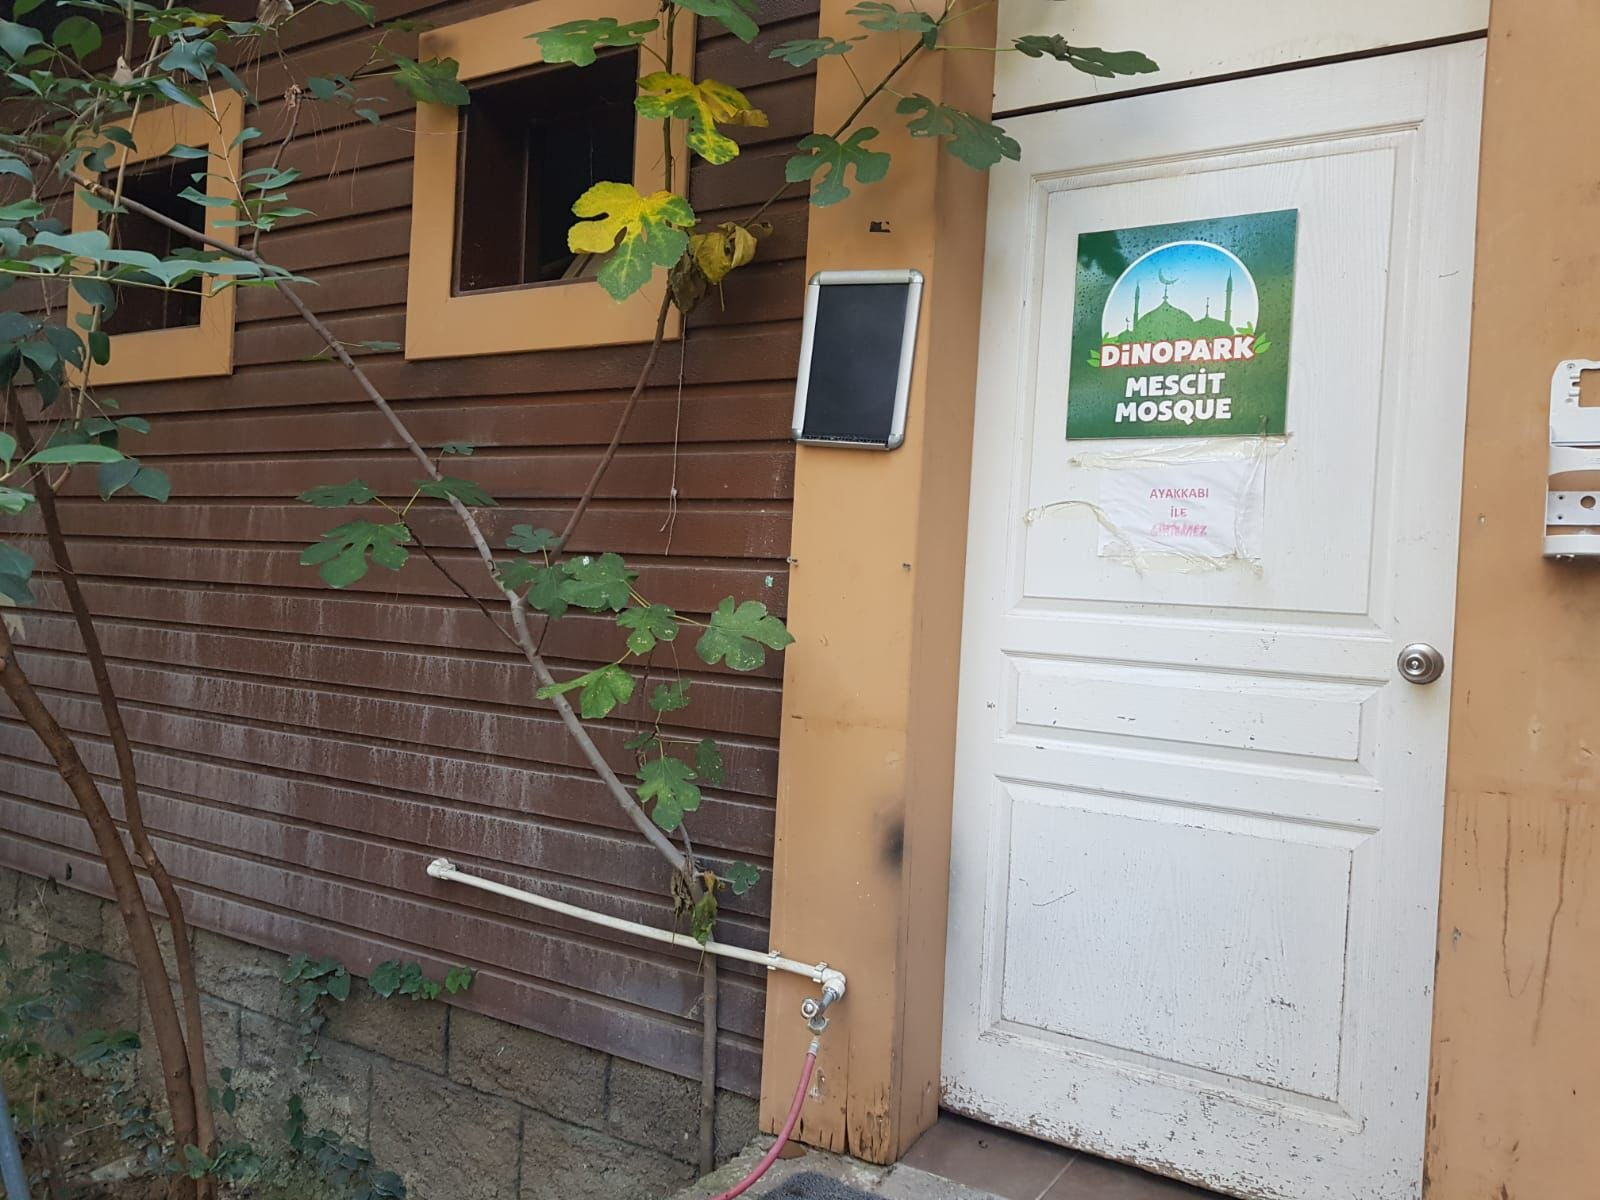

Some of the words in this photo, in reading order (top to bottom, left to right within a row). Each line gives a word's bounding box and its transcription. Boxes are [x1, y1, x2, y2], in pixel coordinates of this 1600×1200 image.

[1125, 368, 1225, 397] MESCİT
[1114, 398, 1231, 425] MOSQUE
[1149, 488, 1209, 499] AYAKKABI
[1170, 505, 1188, 518] İLE
